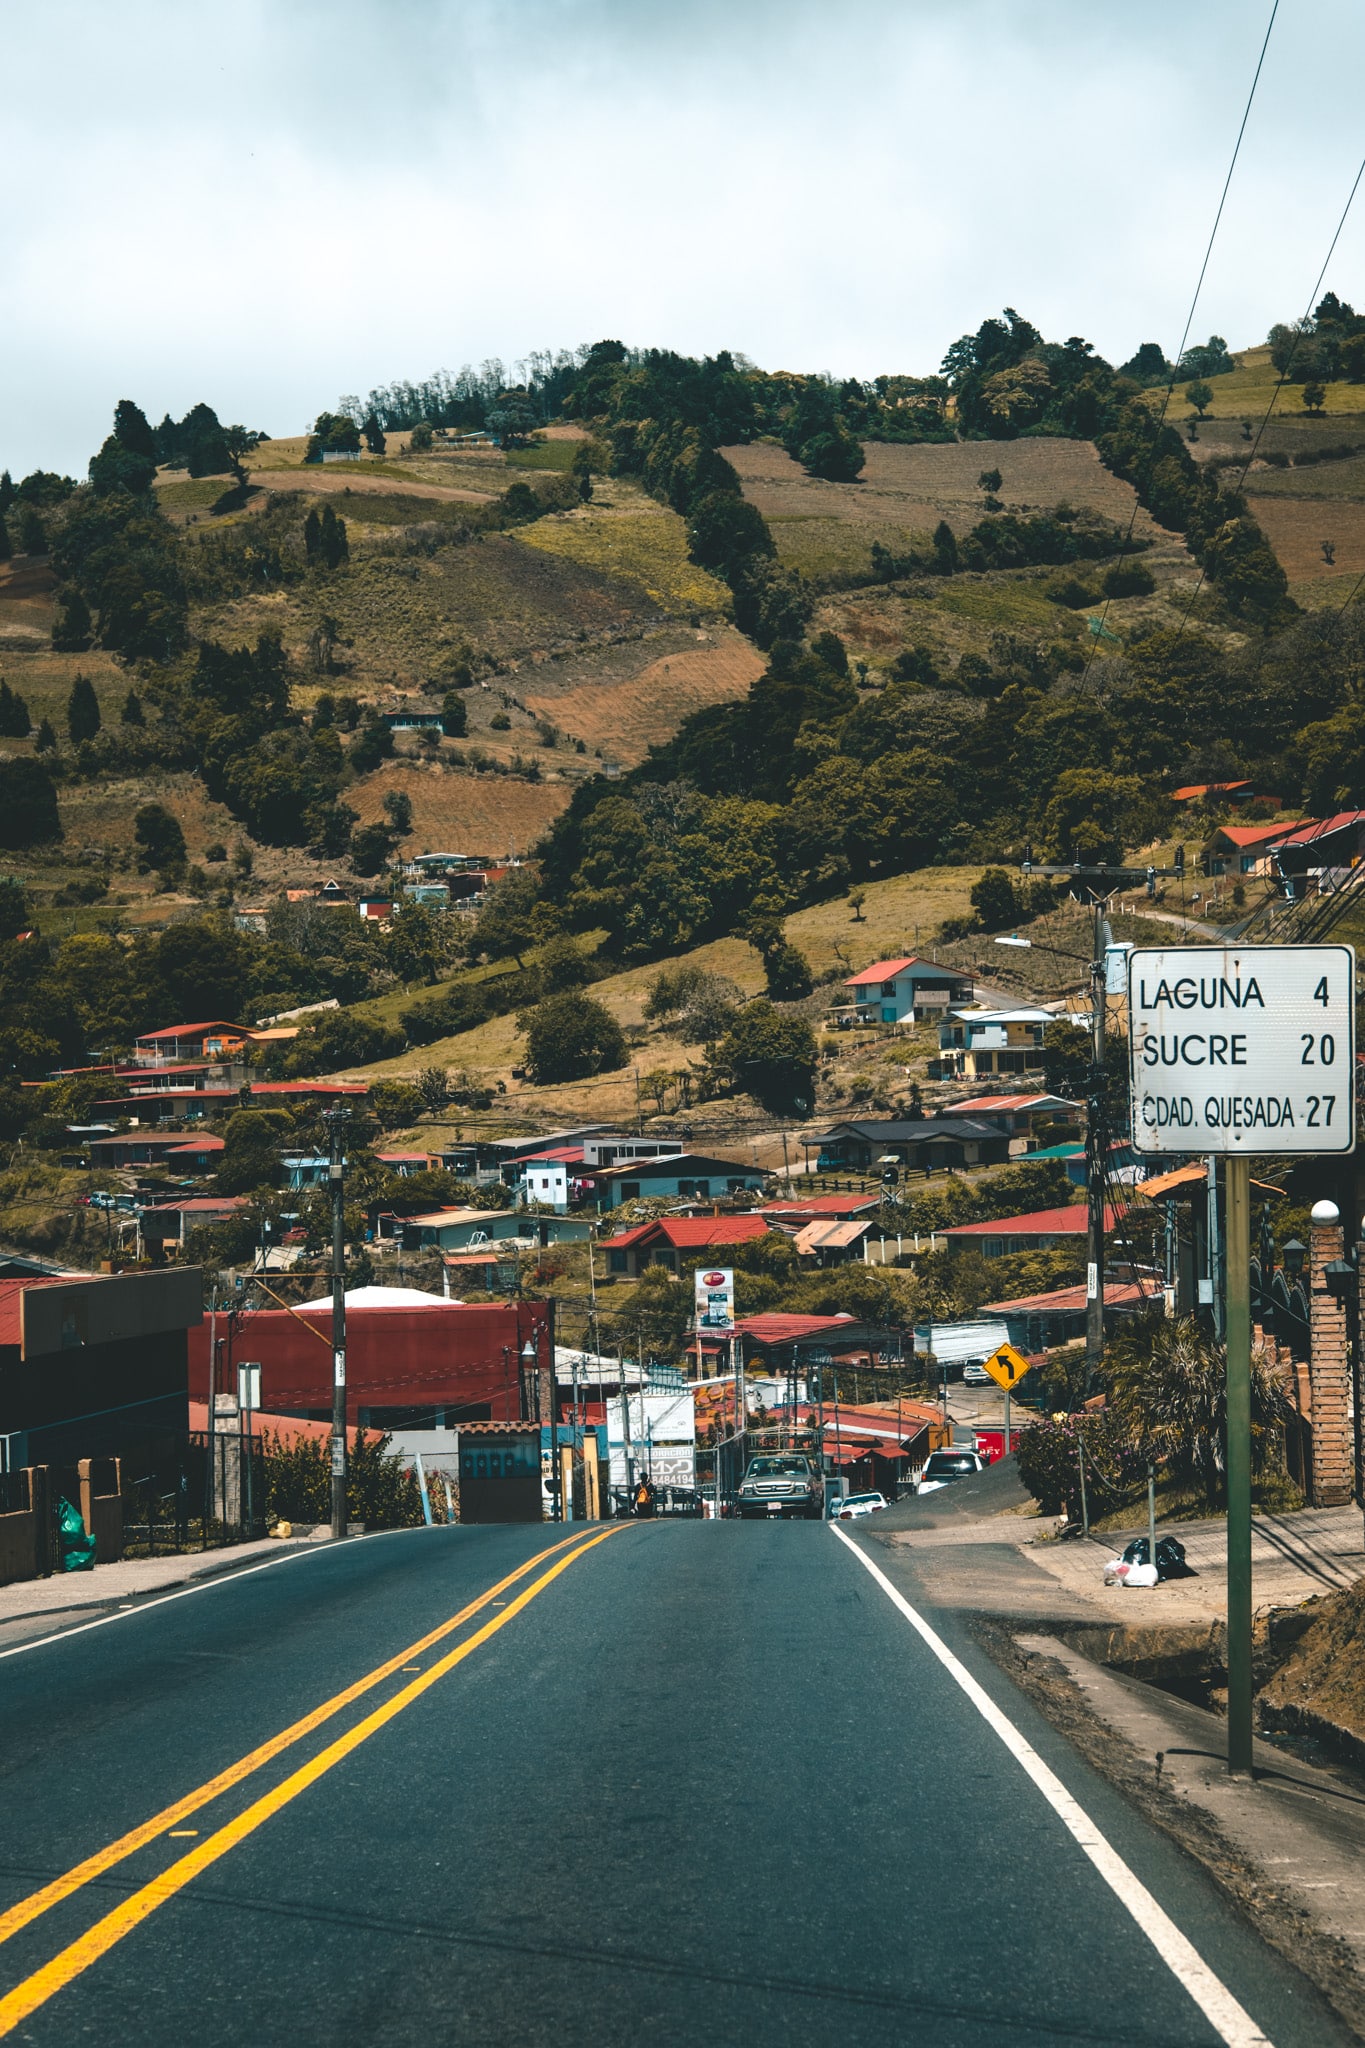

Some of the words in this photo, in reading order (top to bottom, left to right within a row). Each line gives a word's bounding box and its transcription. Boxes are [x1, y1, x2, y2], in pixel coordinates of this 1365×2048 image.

[1140, 977, 1265, 1009] LAGUNA
[1313, 976, 1330, 1007] 4
[1142, 1034, 1248, 1066] SUCRE
[1301, 1034, 1335, 1065] 20
[1142, 1096, 1198, 1128] CDAD.
[1205, 1096, 1295, 1128] QUESADA
[1305, 1095, 1336, 1127] 27
